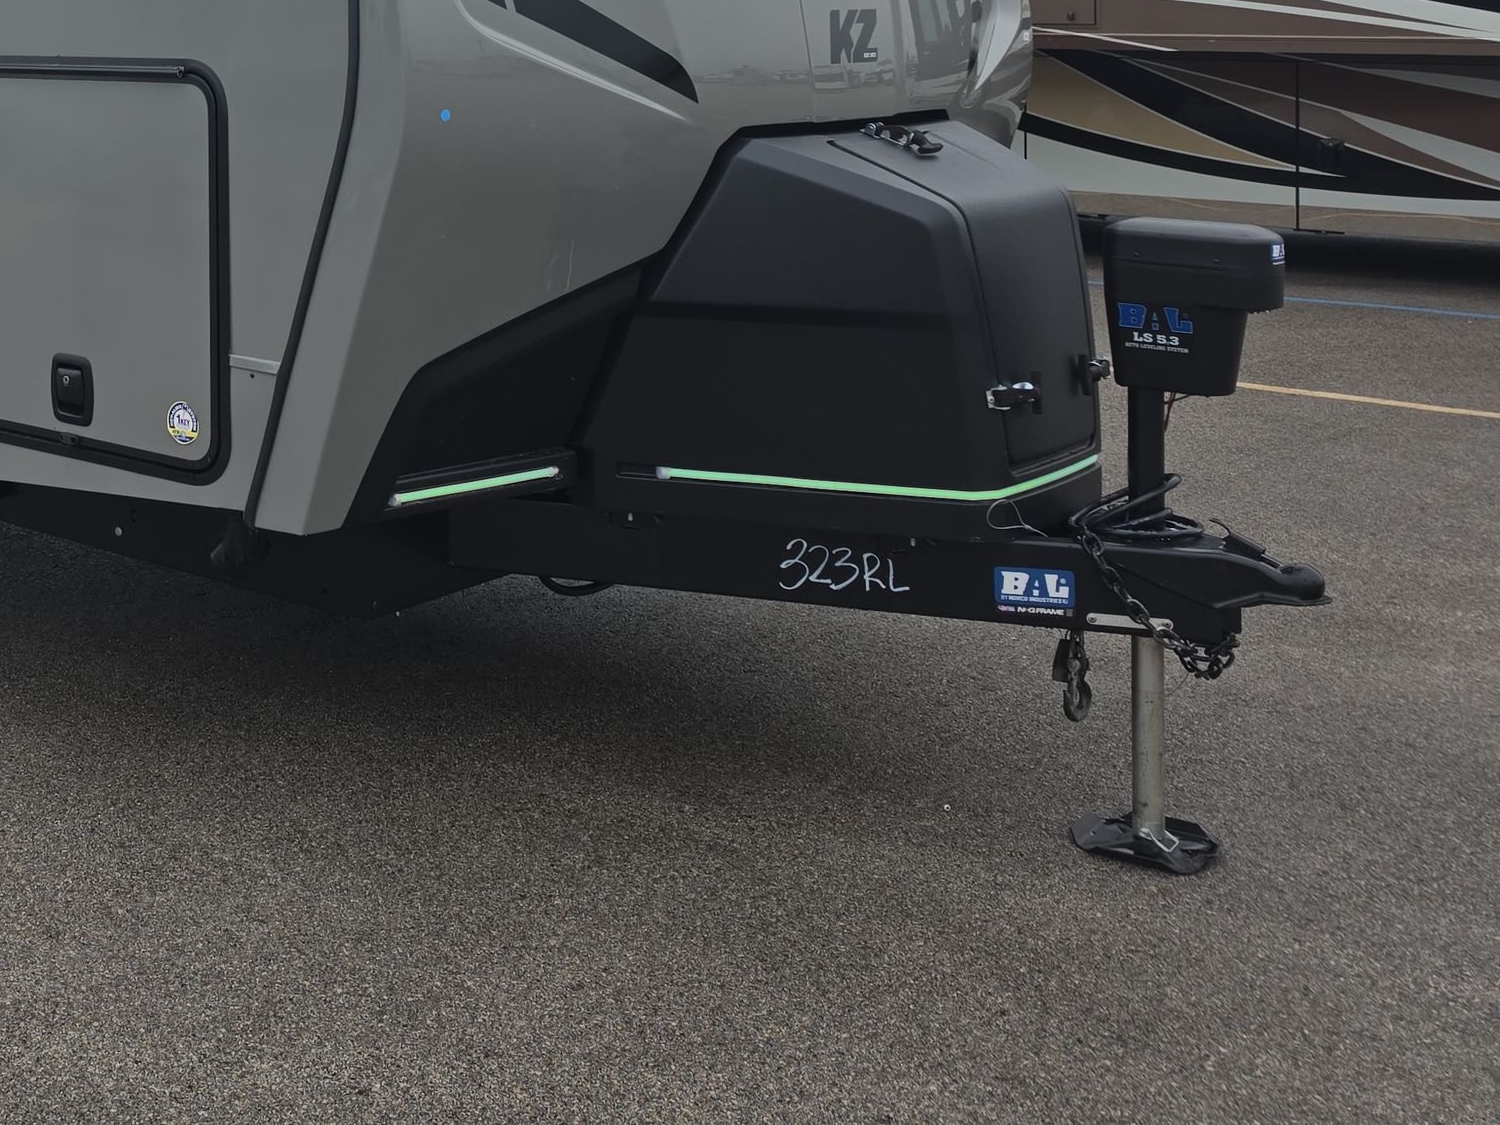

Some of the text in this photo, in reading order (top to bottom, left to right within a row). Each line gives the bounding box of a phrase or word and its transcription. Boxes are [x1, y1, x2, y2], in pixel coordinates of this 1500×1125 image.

[829, 9, 878, 64] KZ
[1117, 302, 1193, 334] BAL
[1133, 331, 1153, 343] LS
[778, 538, 910, 592] 323RL
[1001, 570, 1070, 598] BAL
